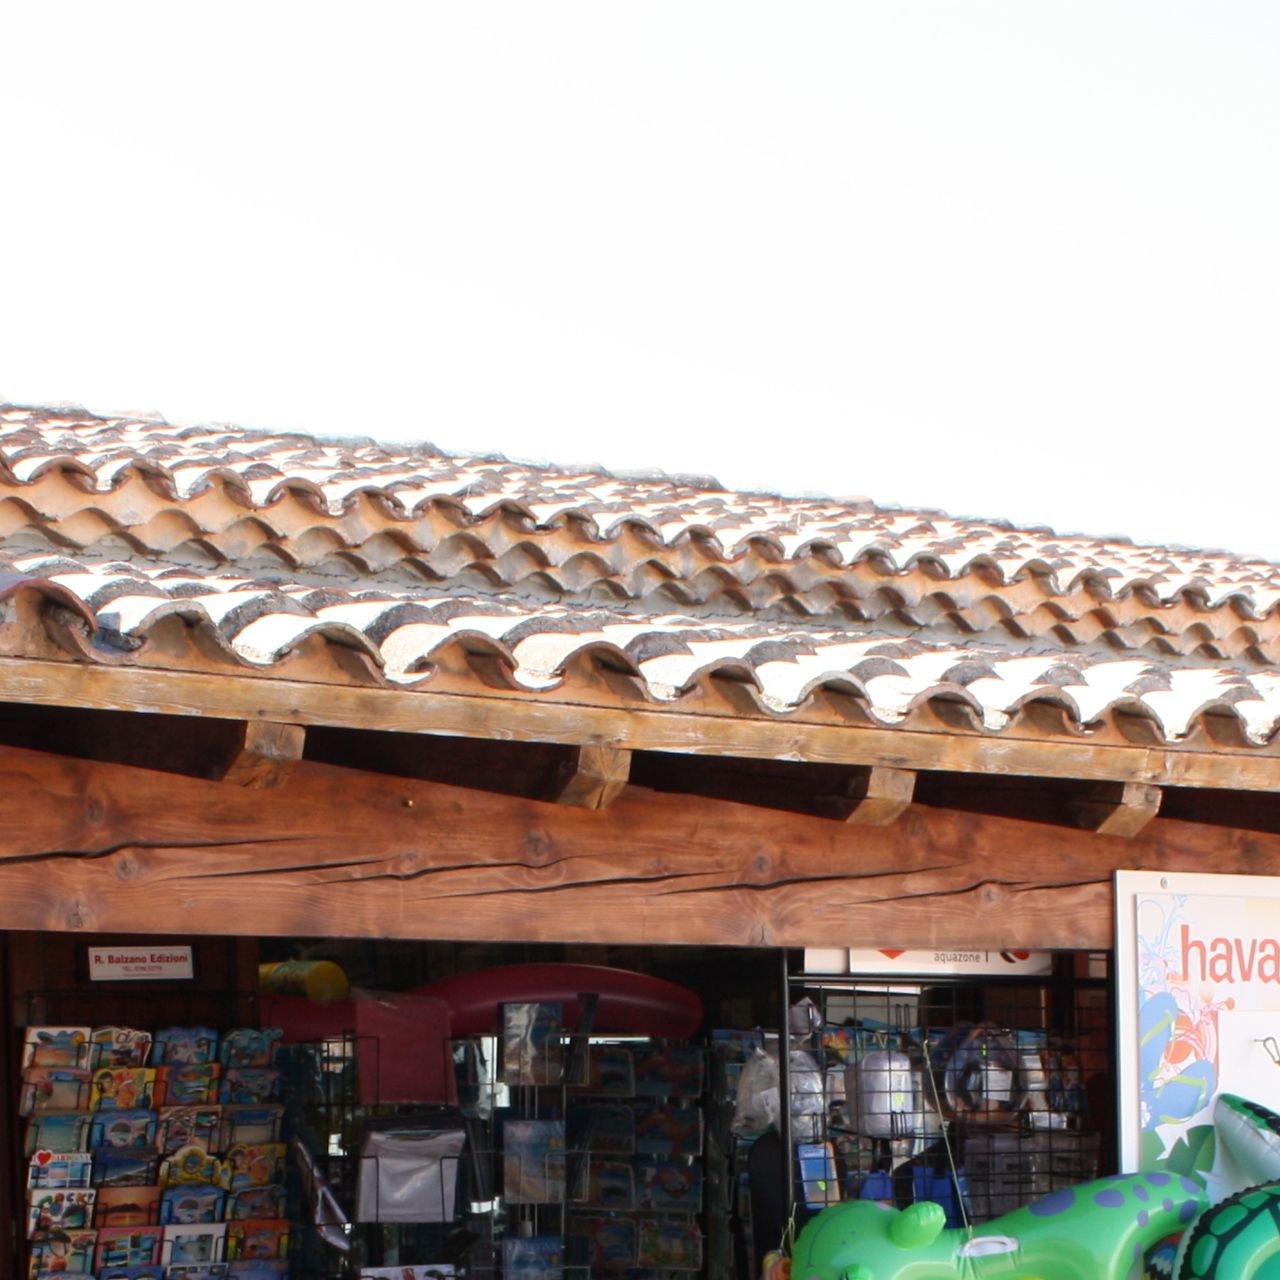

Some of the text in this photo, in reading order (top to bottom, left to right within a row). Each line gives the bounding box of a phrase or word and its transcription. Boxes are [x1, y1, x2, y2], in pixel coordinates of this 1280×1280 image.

[94, 953, 188, 964] R. Balzano Edizioni
[933, 952, 982, 963] aquazone
